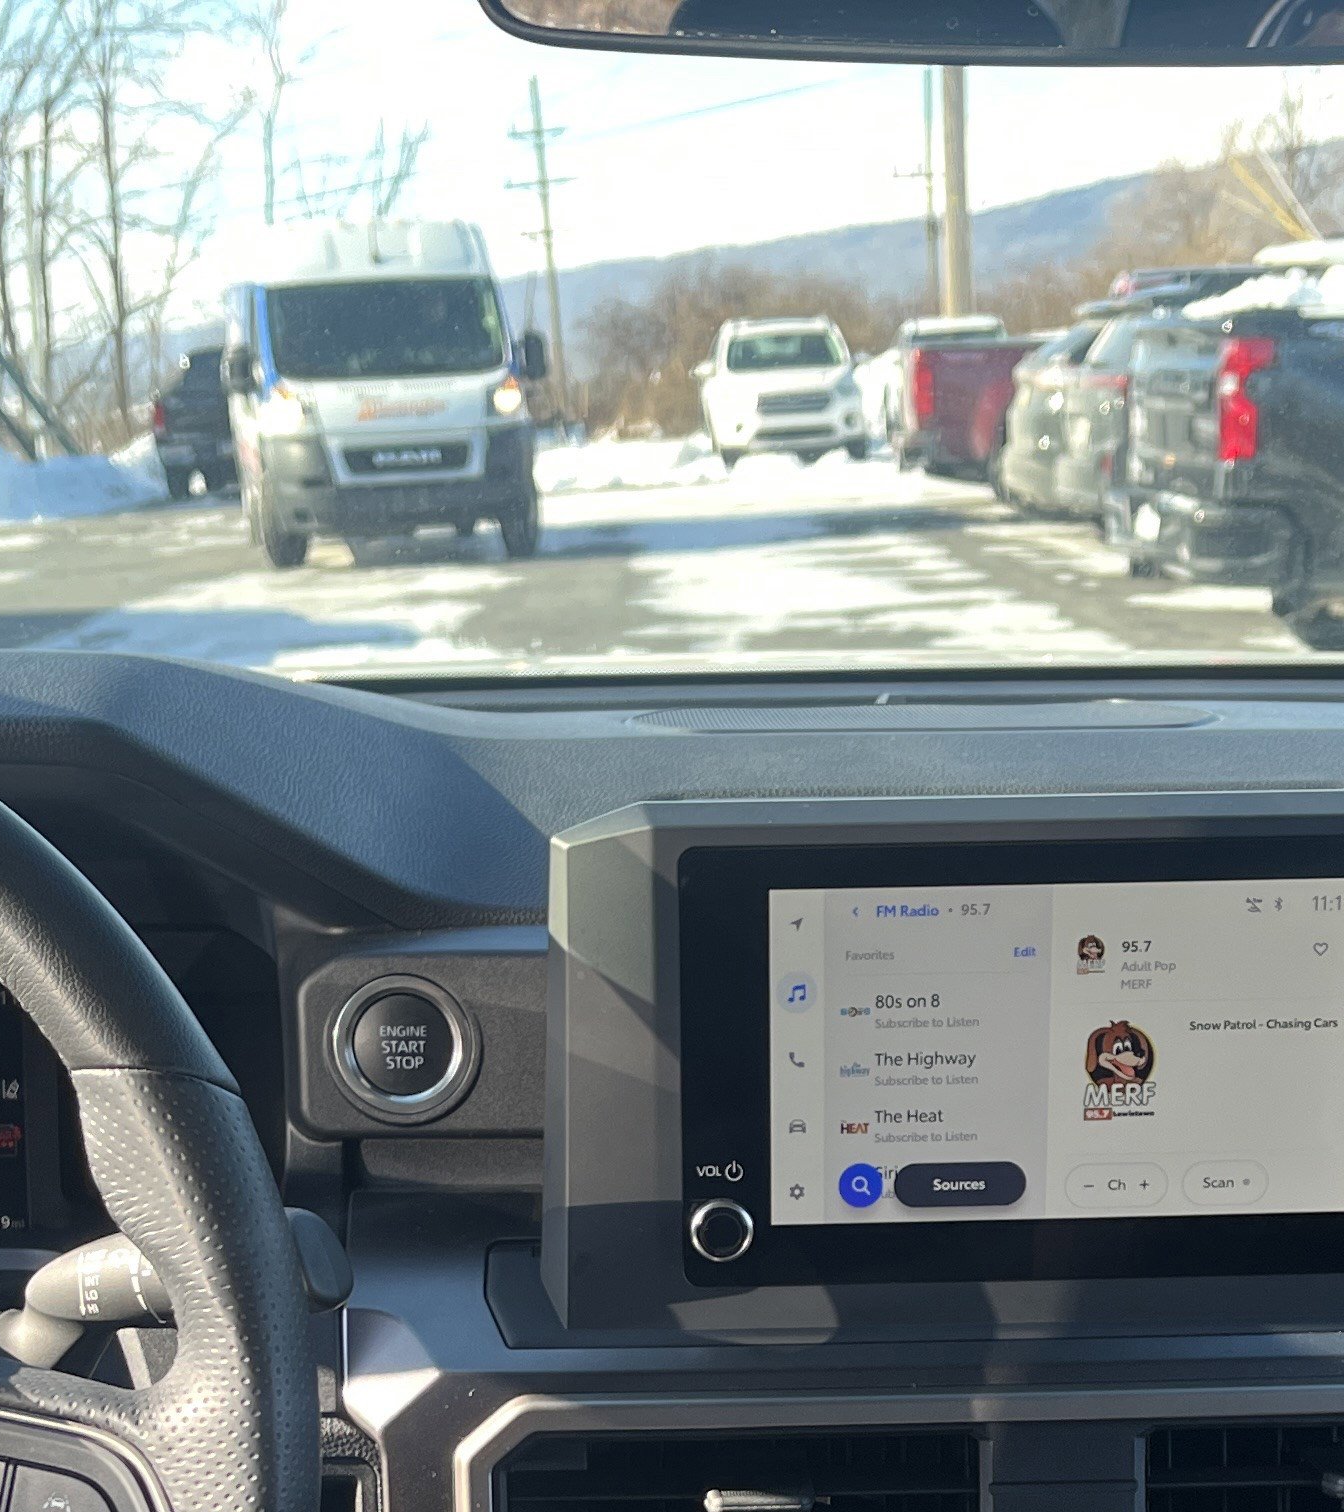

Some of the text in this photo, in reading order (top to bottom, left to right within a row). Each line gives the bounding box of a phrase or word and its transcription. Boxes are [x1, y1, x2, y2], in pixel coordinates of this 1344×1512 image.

[876, 903, 991, 918] FM Radio 95.7
[1013, 946, 1037, 958] Edit
[1121, 940, 1152, 953] 95.7
[845, 949, 895, 961] Favorites
[1121, 960, 1177, 974] Adult Pop
[1120, 978, 1153, 990] MERF
[875, 993, 941, 1009] 80s on 8
[875, 1017, 980, 1029] Subscribe to Listen
[1189, 1020, 1222, 1031] Snow
[1223, 1019, 1258, 1030] Patrol
[1266, 1018, 1312, 1032] Chasing
[1313, 1017, 1339, 1029] Cars
[379, 1025, 428, 1038] ENGINE
[381, 1040, 427, 1053] START
[385, 1056, 424, 1070] STOP
[875, 1051, 977, 1070] The Highway
[874, 1074, 979, 1086] Subscribe to Listen
[1083, 1080, 1156, 1107] MERF
[874, 1110, 944, 1123] The Heat
[840, 1122, 870, 1134] HEAT
[874, 1132, 978, 1143] Subscribe to Listen
[696, 1164, 722, 1178] VOL
[932, 1178, 986, 1191] Sources
[1107, 1178, 1126, 1191] Ch
[1202, 1177, 1235, 1189] Scan
[84, 1289, 99, 1301] LO
